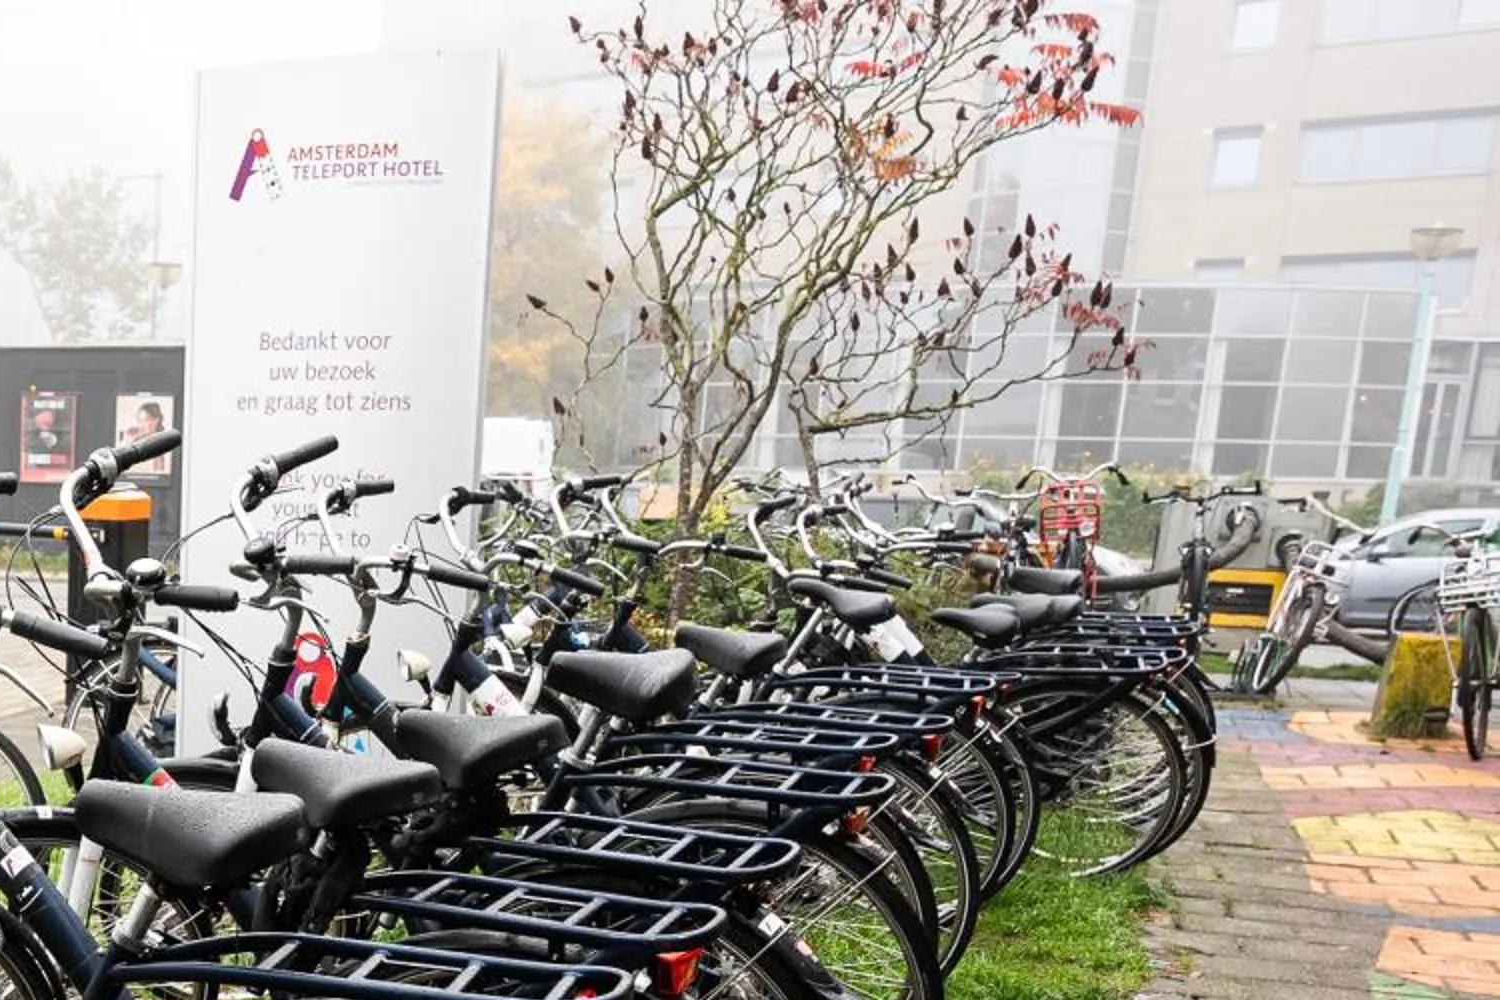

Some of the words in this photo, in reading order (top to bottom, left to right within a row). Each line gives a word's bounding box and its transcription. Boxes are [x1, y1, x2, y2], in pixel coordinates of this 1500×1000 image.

[287, 143, 399, 162] AMSTERDAM
[292, 162, 379, 180] TELEPORT
[383, 160, 444, 177] HOTEL
[259, 330, 337, 351] Bedankt
[344, 334, 392, 351] voor
[269, 366, 298, 381] uw
[305, 360, 376, 381] bezoek
[237, 395, 259, 411] en
[264, 394, 318, 416] graag
[326, 392, 354, 411] tot
[360, 391, 412, 411] ziens
[351, 530, 372, 548] to
